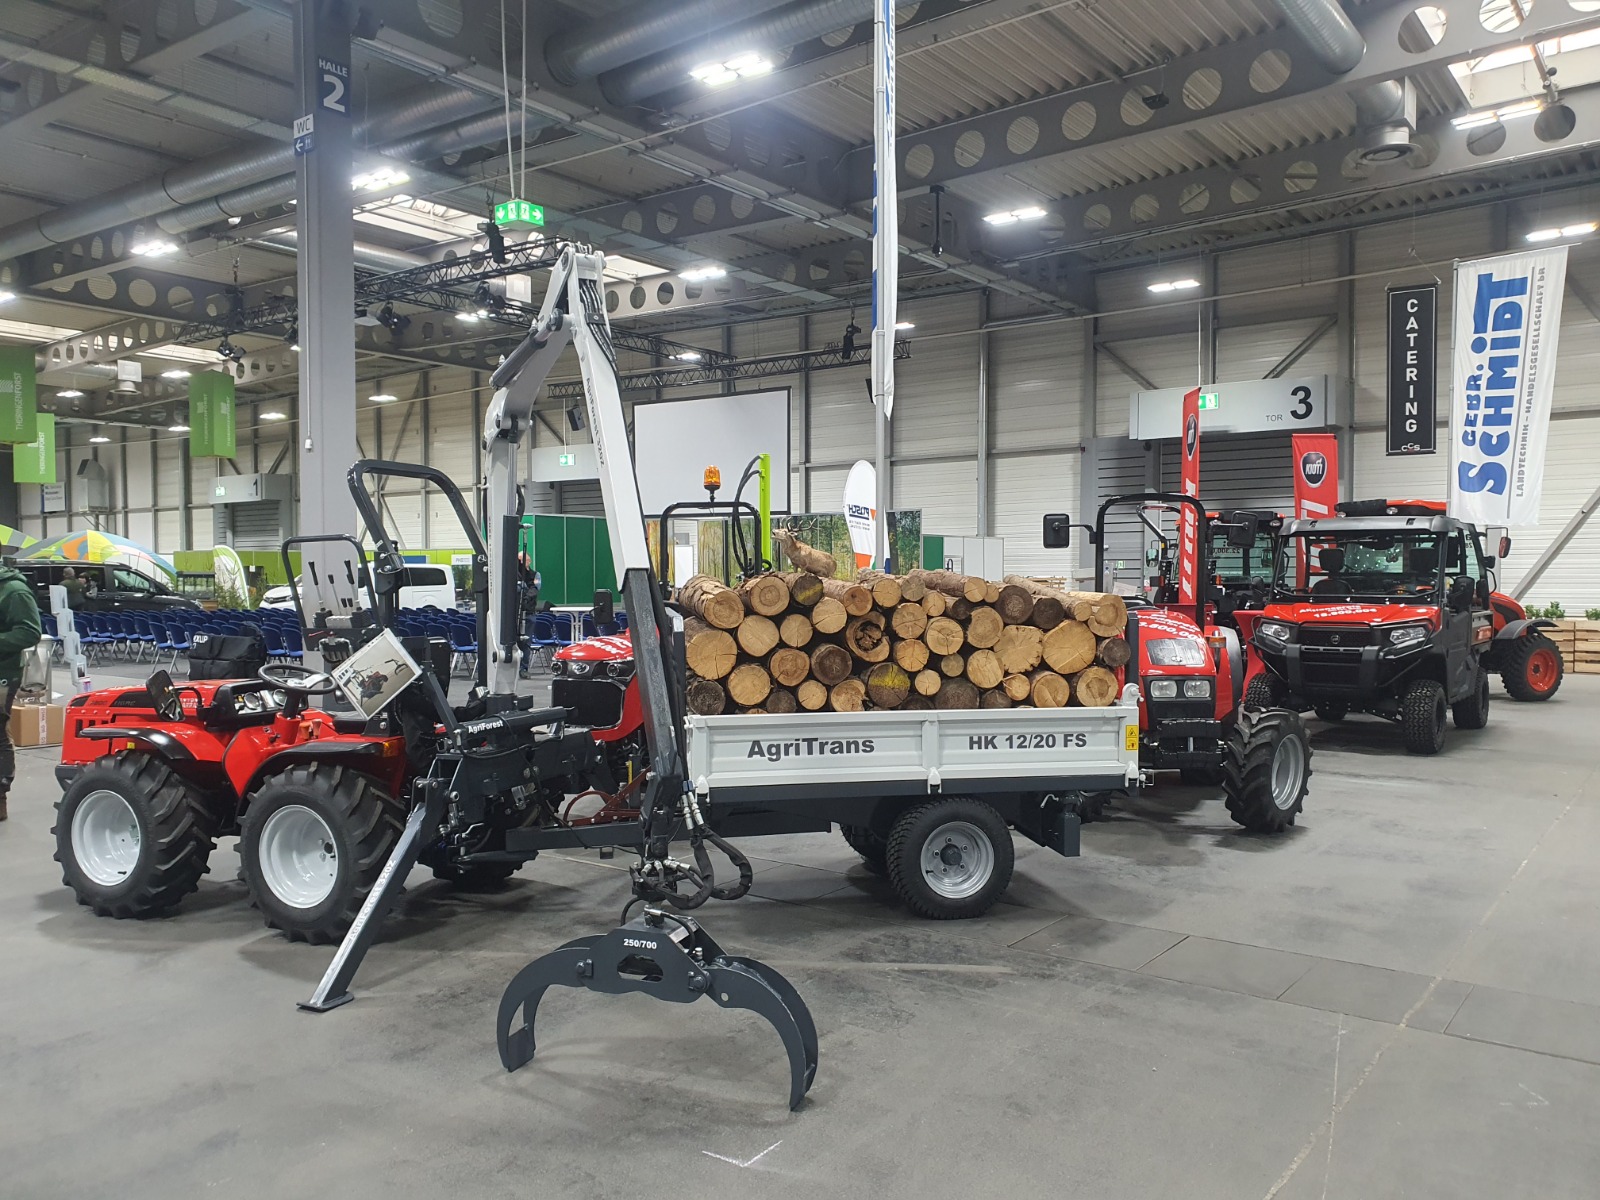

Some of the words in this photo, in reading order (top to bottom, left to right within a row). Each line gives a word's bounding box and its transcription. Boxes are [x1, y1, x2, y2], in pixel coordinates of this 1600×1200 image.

[318, 58, 348, 77] HALLE
[323, 74, 345, 113] 2
[296, 117, 311, 134] WC
[1405, 298, 1419, 433] CATERING
[1515, 423, 1529, 498] LANDTECHNIK
[1525, 286, 1545, 414] HANDELSGESELLSCHAFT
[1265, 414, 1283, 422] TOR
[1289, 385, 1314, 420] 3
[1461, 363, 1484, 447] GEBR.
[252, 478, 259, 496] 1
[468, 719, 504, 734] AgriForest
[747, 737, 875, 762] AgriTrans
[968, 735, 998, 750] HK
[1005, 733, 1057, 749] 12/20
[1063, 733, 1087, 748] FS
[623, 938, 657, 950] 250/700
